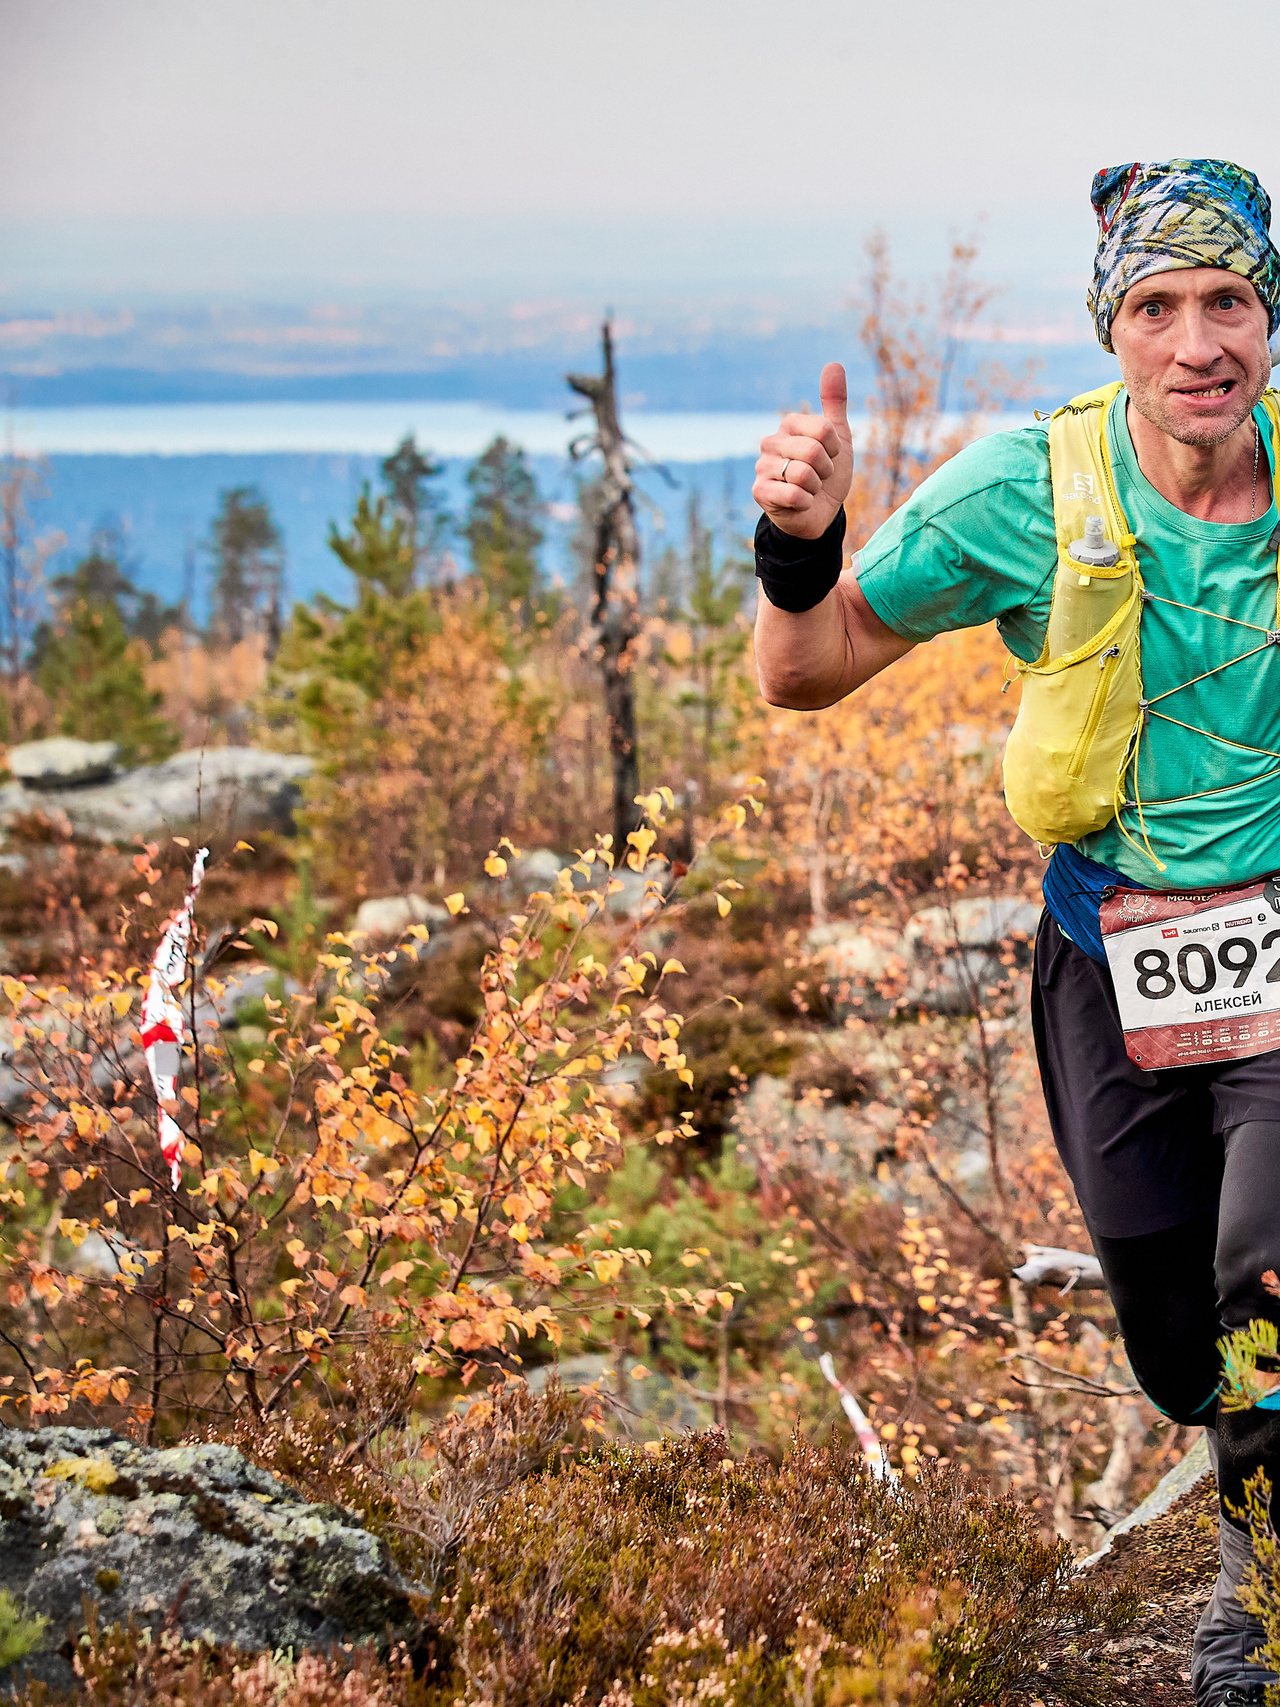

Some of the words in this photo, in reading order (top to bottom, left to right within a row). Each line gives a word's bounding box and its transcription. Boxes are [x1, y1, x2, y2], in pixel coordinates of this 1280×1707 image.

[1116, 909, 1145, 923] Mountain
[1144, 904, 1158, 919] Race
[1194, 990, 1262, 1013] АЛЕКСЕЙ
